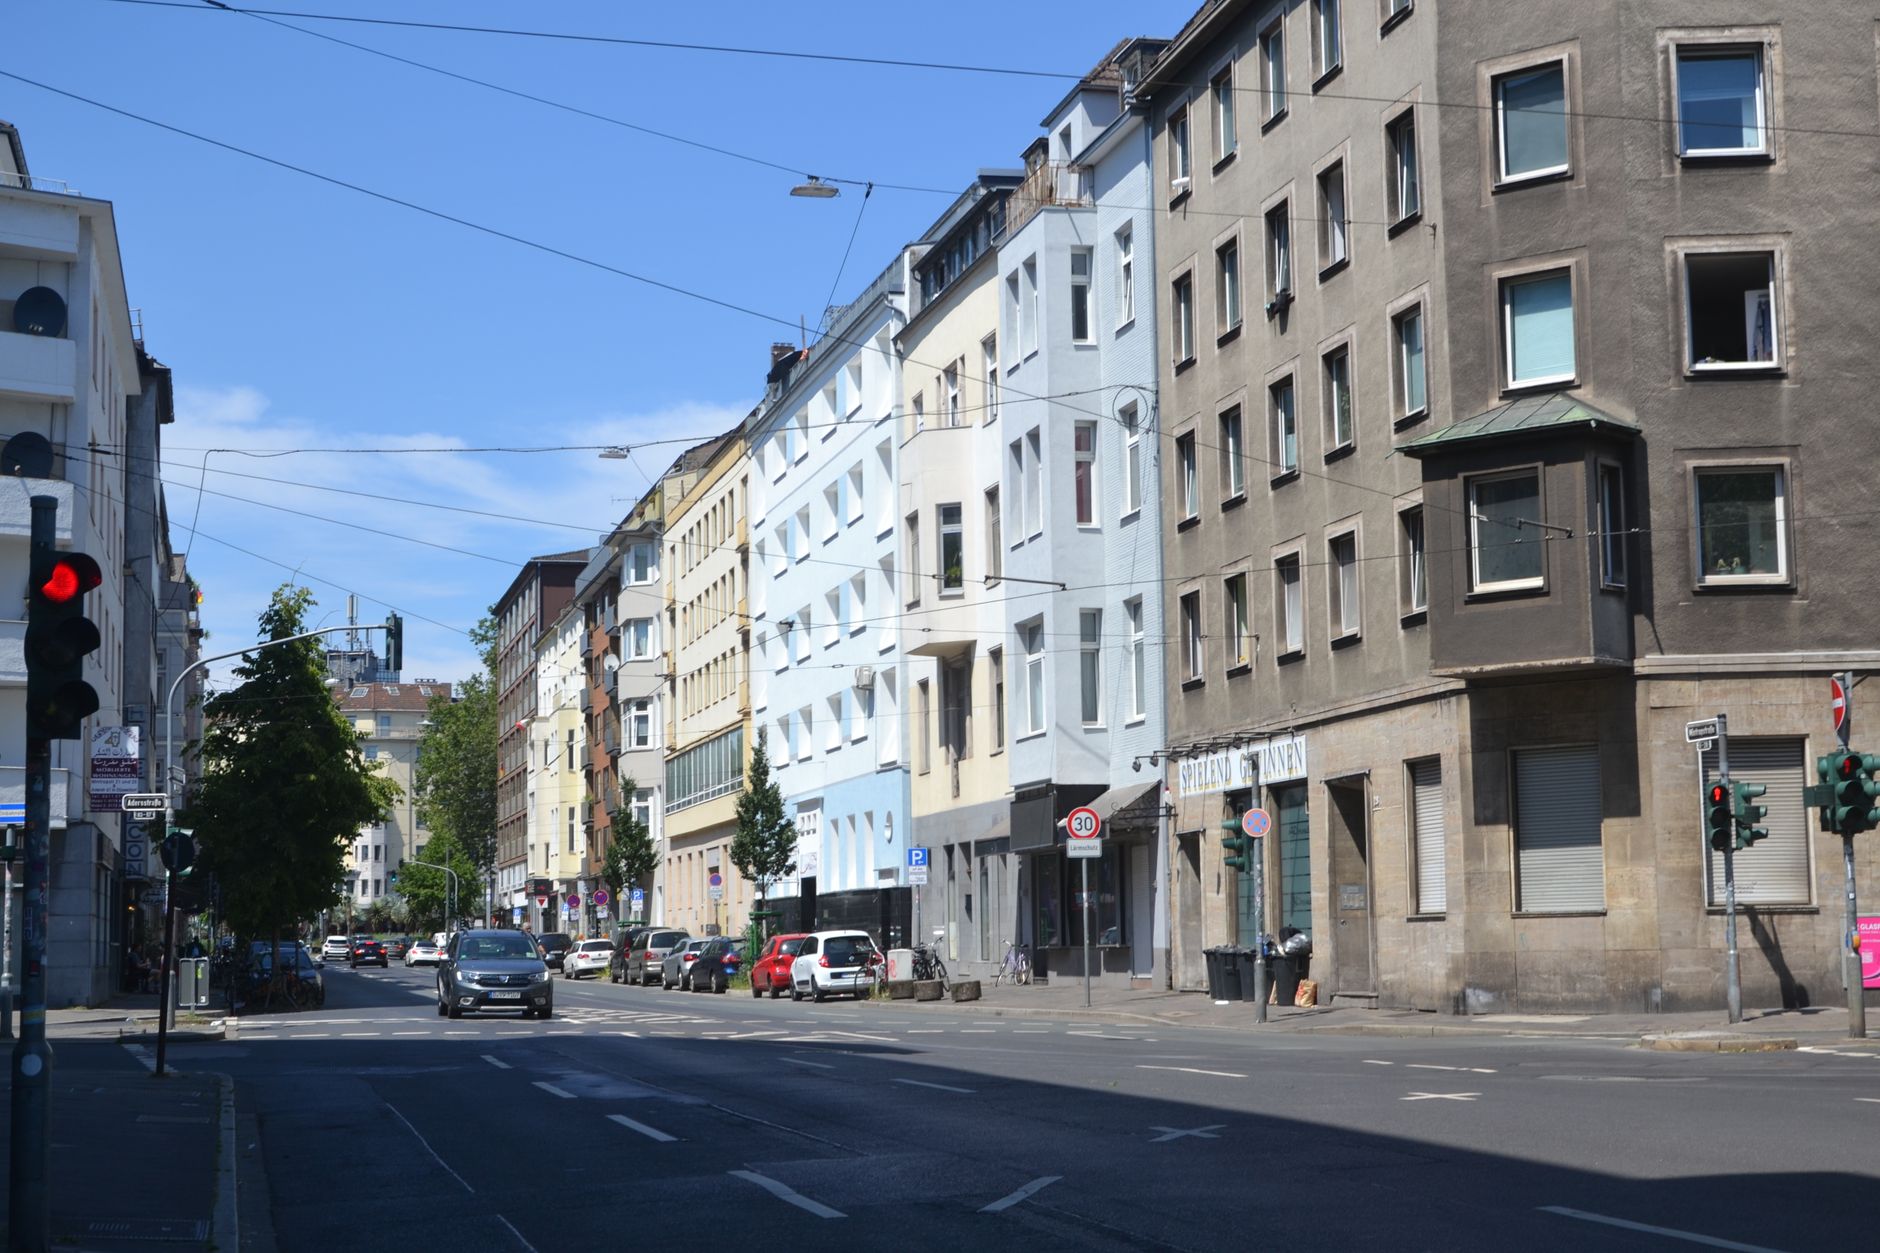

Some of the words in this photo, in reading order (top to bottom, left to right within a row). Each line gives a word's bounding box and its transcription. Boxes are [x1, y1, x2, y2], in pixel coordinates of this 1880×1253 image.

[1181, 756, 1232, 792] SPIELEND
[1239, 741, 1303, 782] GEINNEN
[127, 798, 163, 808] Adersstraße
[1074, 816, 1093, 831] 30
[911, 850, 922, 865] P
